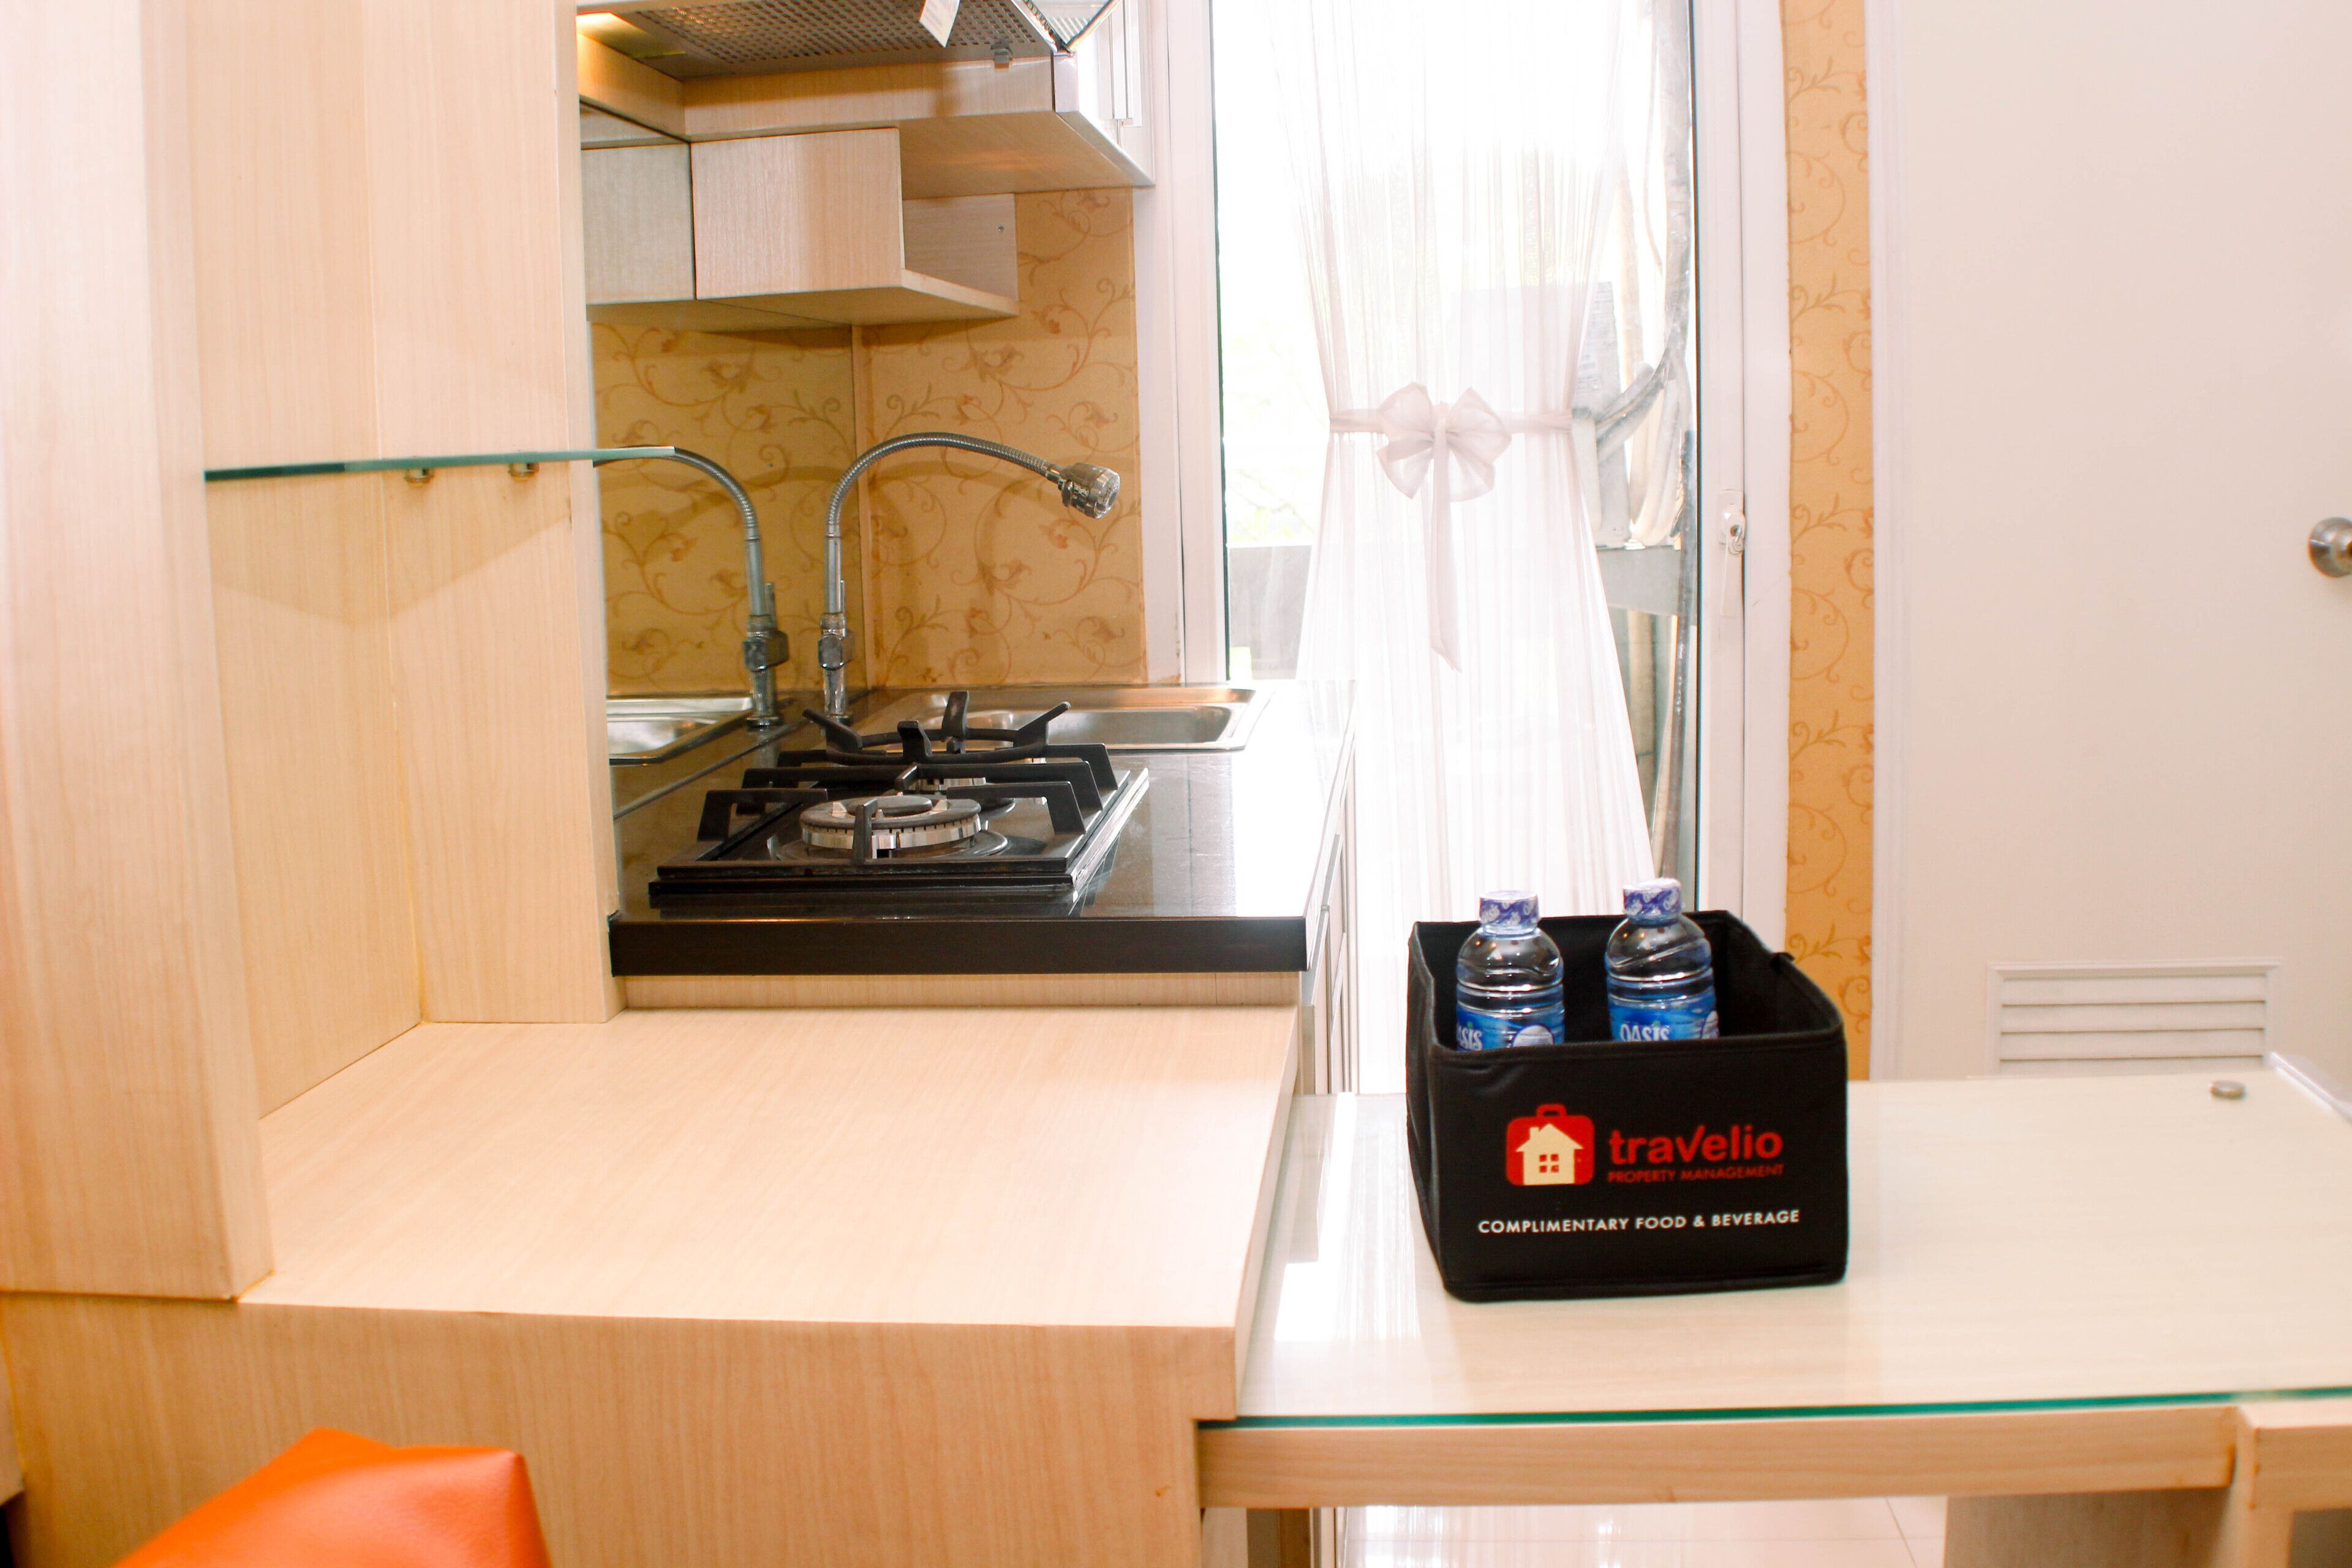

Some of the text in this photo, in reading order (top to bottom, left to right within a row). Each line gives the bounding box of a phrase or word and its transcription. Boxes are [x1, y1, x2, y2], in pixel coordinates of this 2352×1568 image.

[1618, 1020, 1670, 1041] OASIS
[1610, 1126, 1783, 1164] travelio
[1608, 1165, 1784, 1183] PROPERTY MANAGEMENT
[1478, 1210, 1799, 1233] COMPLIMENTARY FOOD & BEVERAGE
